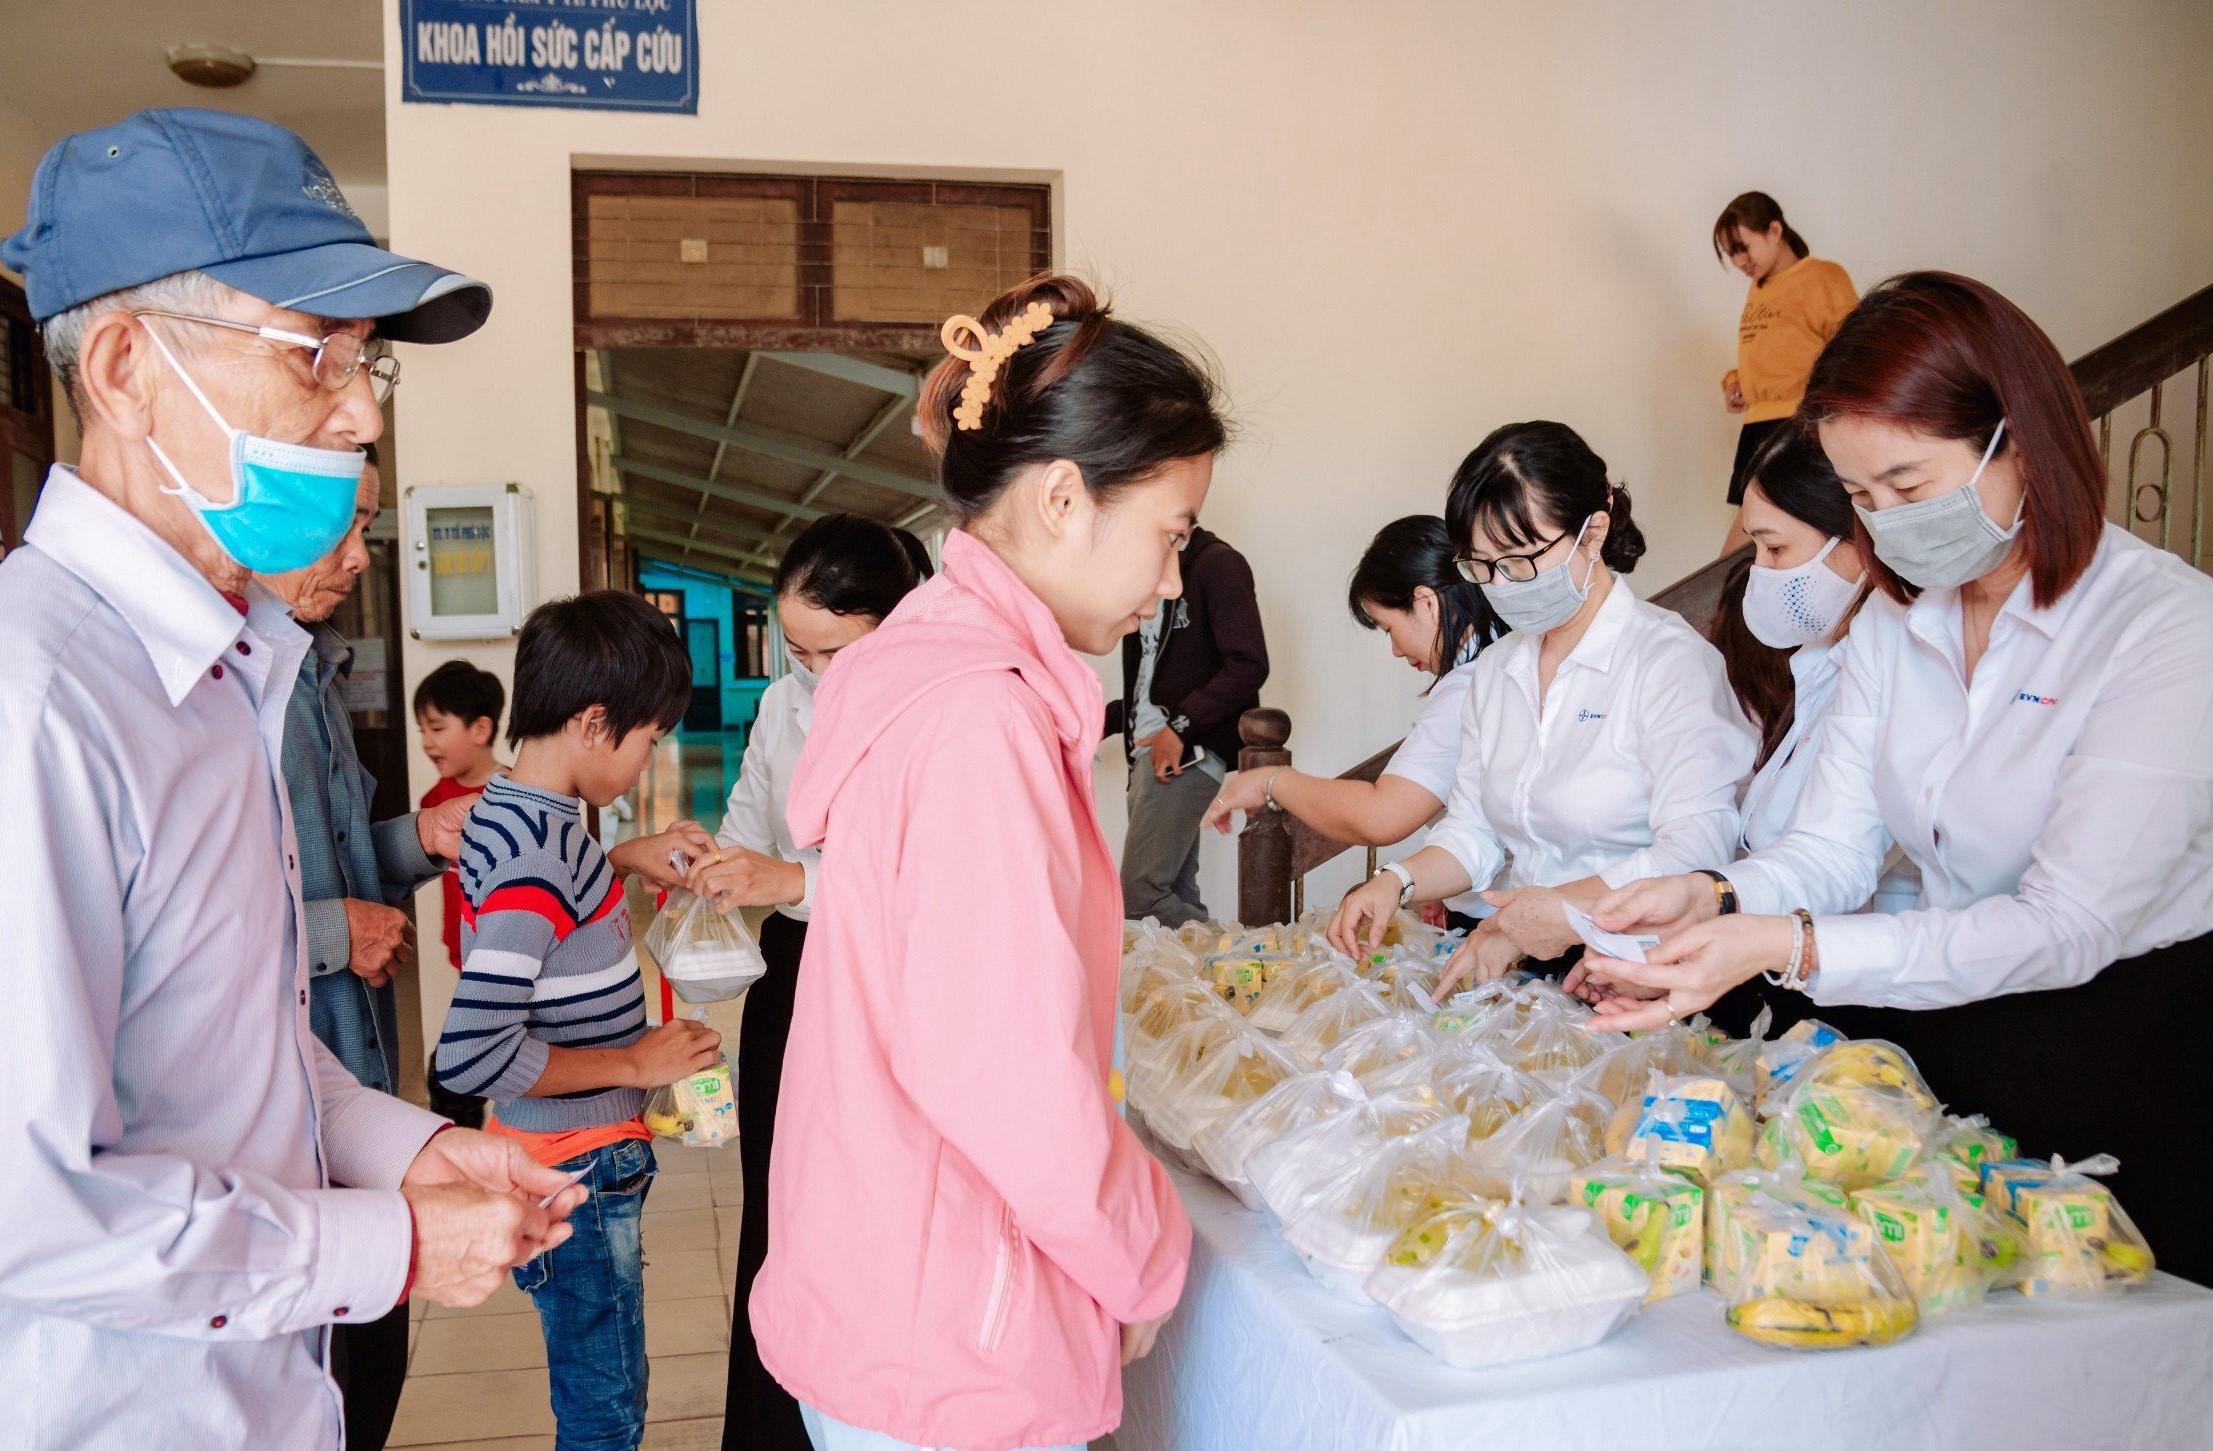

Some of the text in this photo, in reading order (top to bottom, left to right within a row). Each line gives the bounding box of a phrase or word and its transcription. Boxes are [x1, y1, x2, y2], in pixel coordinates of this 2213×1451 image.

[418, 13, 682, 74] KHOA HỒI SỨC CẤP CỨU
